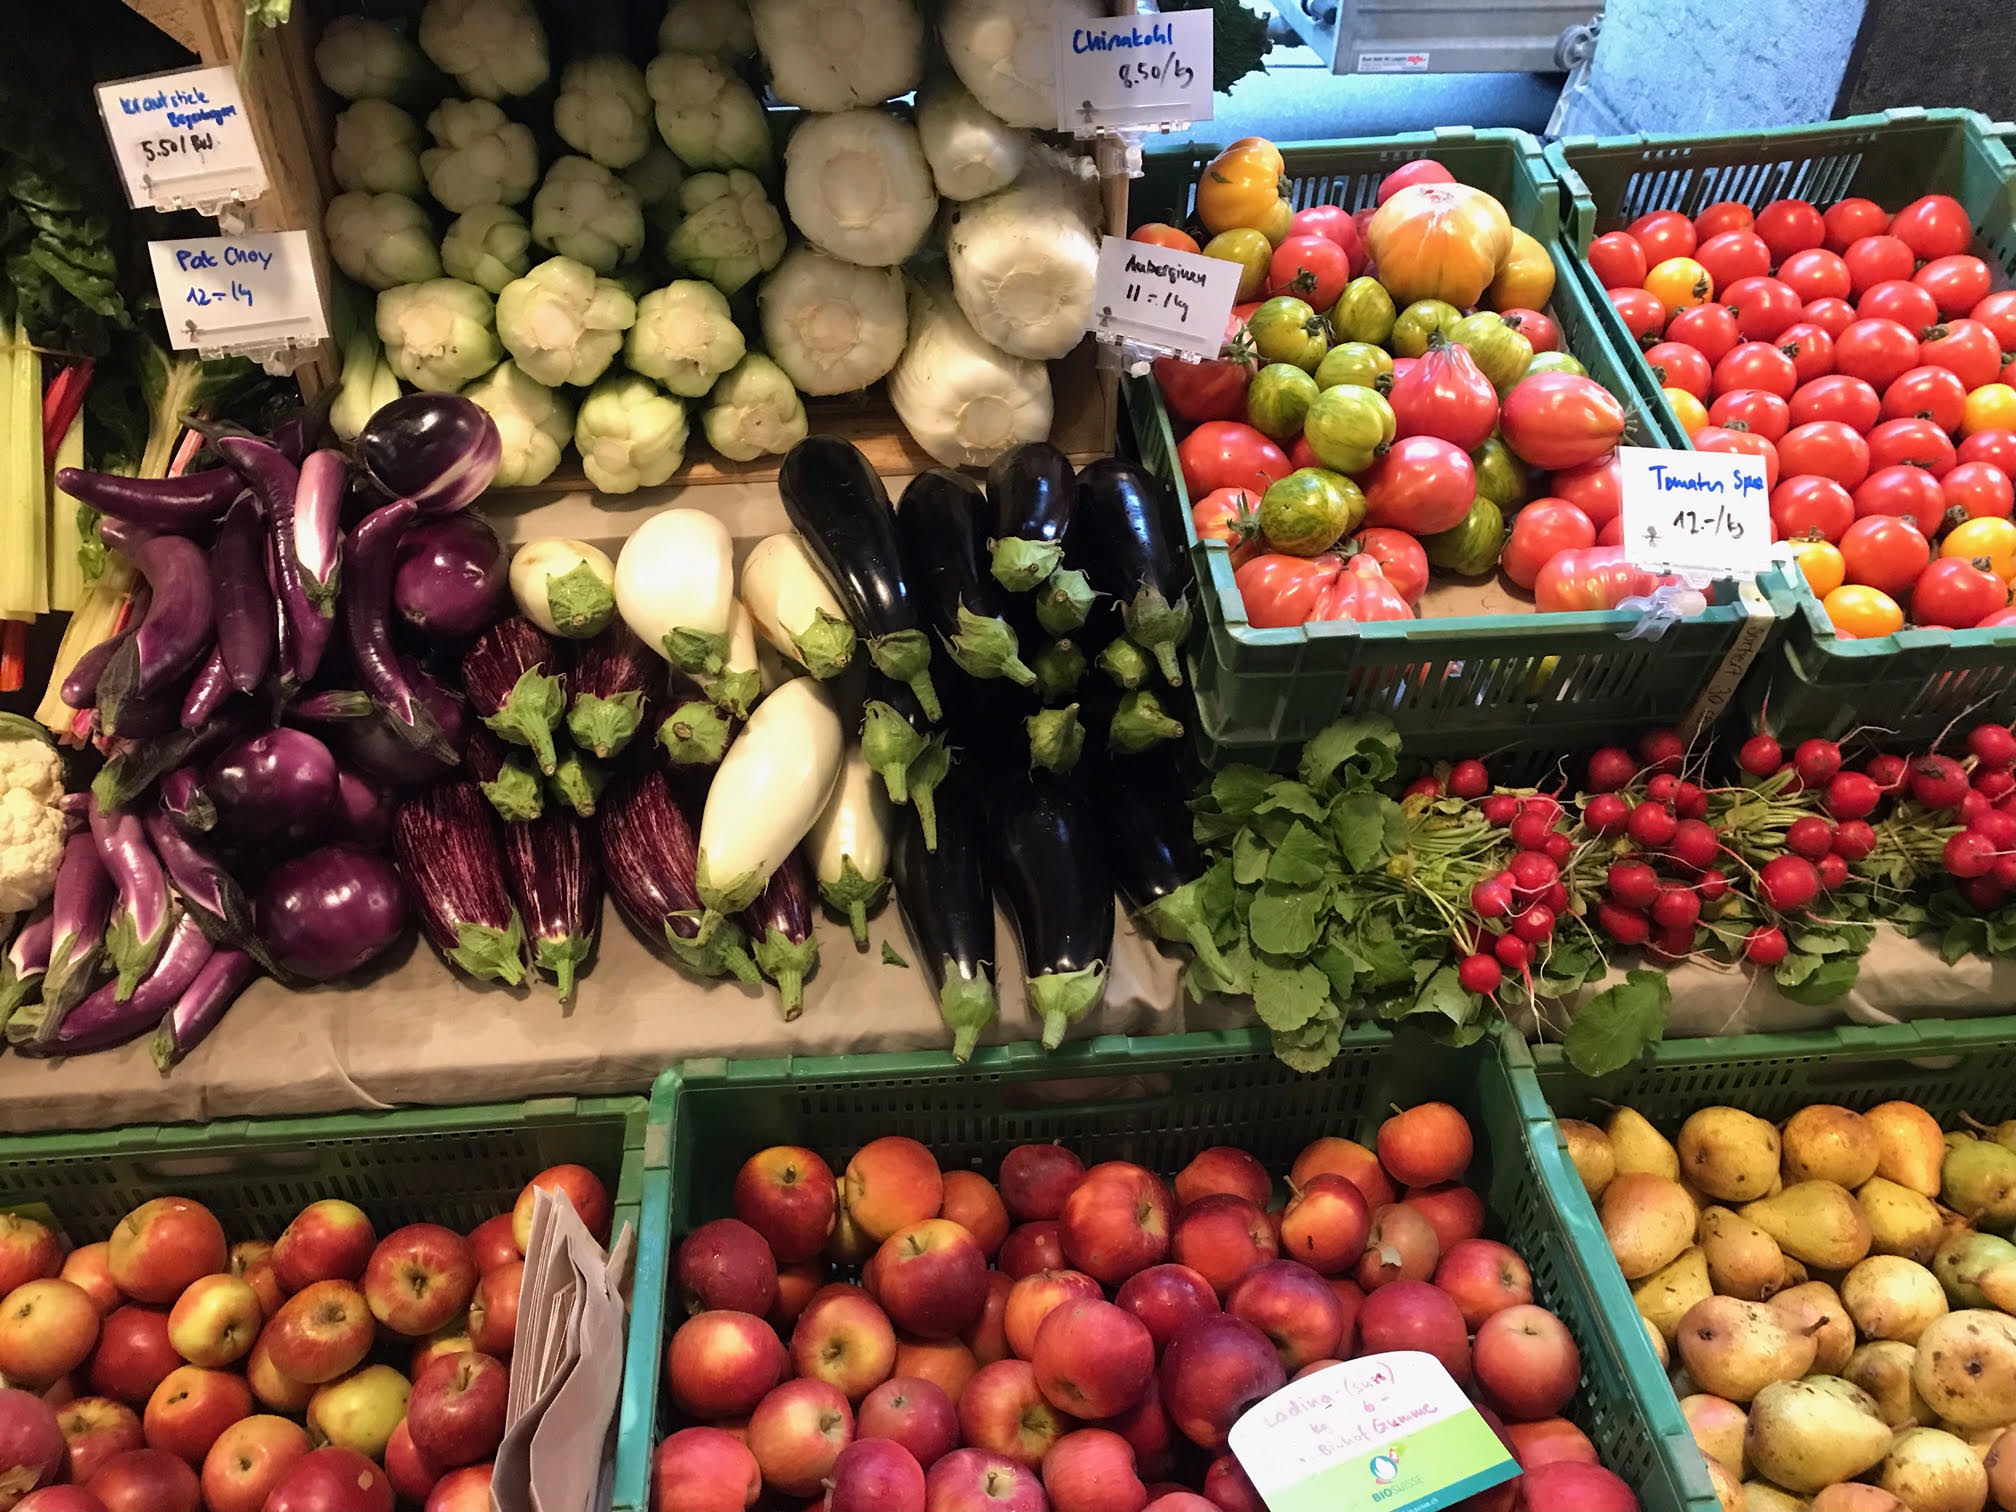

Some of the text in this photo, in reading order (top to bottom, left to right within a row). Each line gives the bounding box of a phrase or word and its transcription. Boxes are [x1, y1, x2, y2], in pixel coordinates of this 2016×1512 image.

[1072, 22, 1174, 54] Chinakohl
[175, 246, 273, 272] Pak Choy
[1124, 253, 1207, 288] Auberginen
